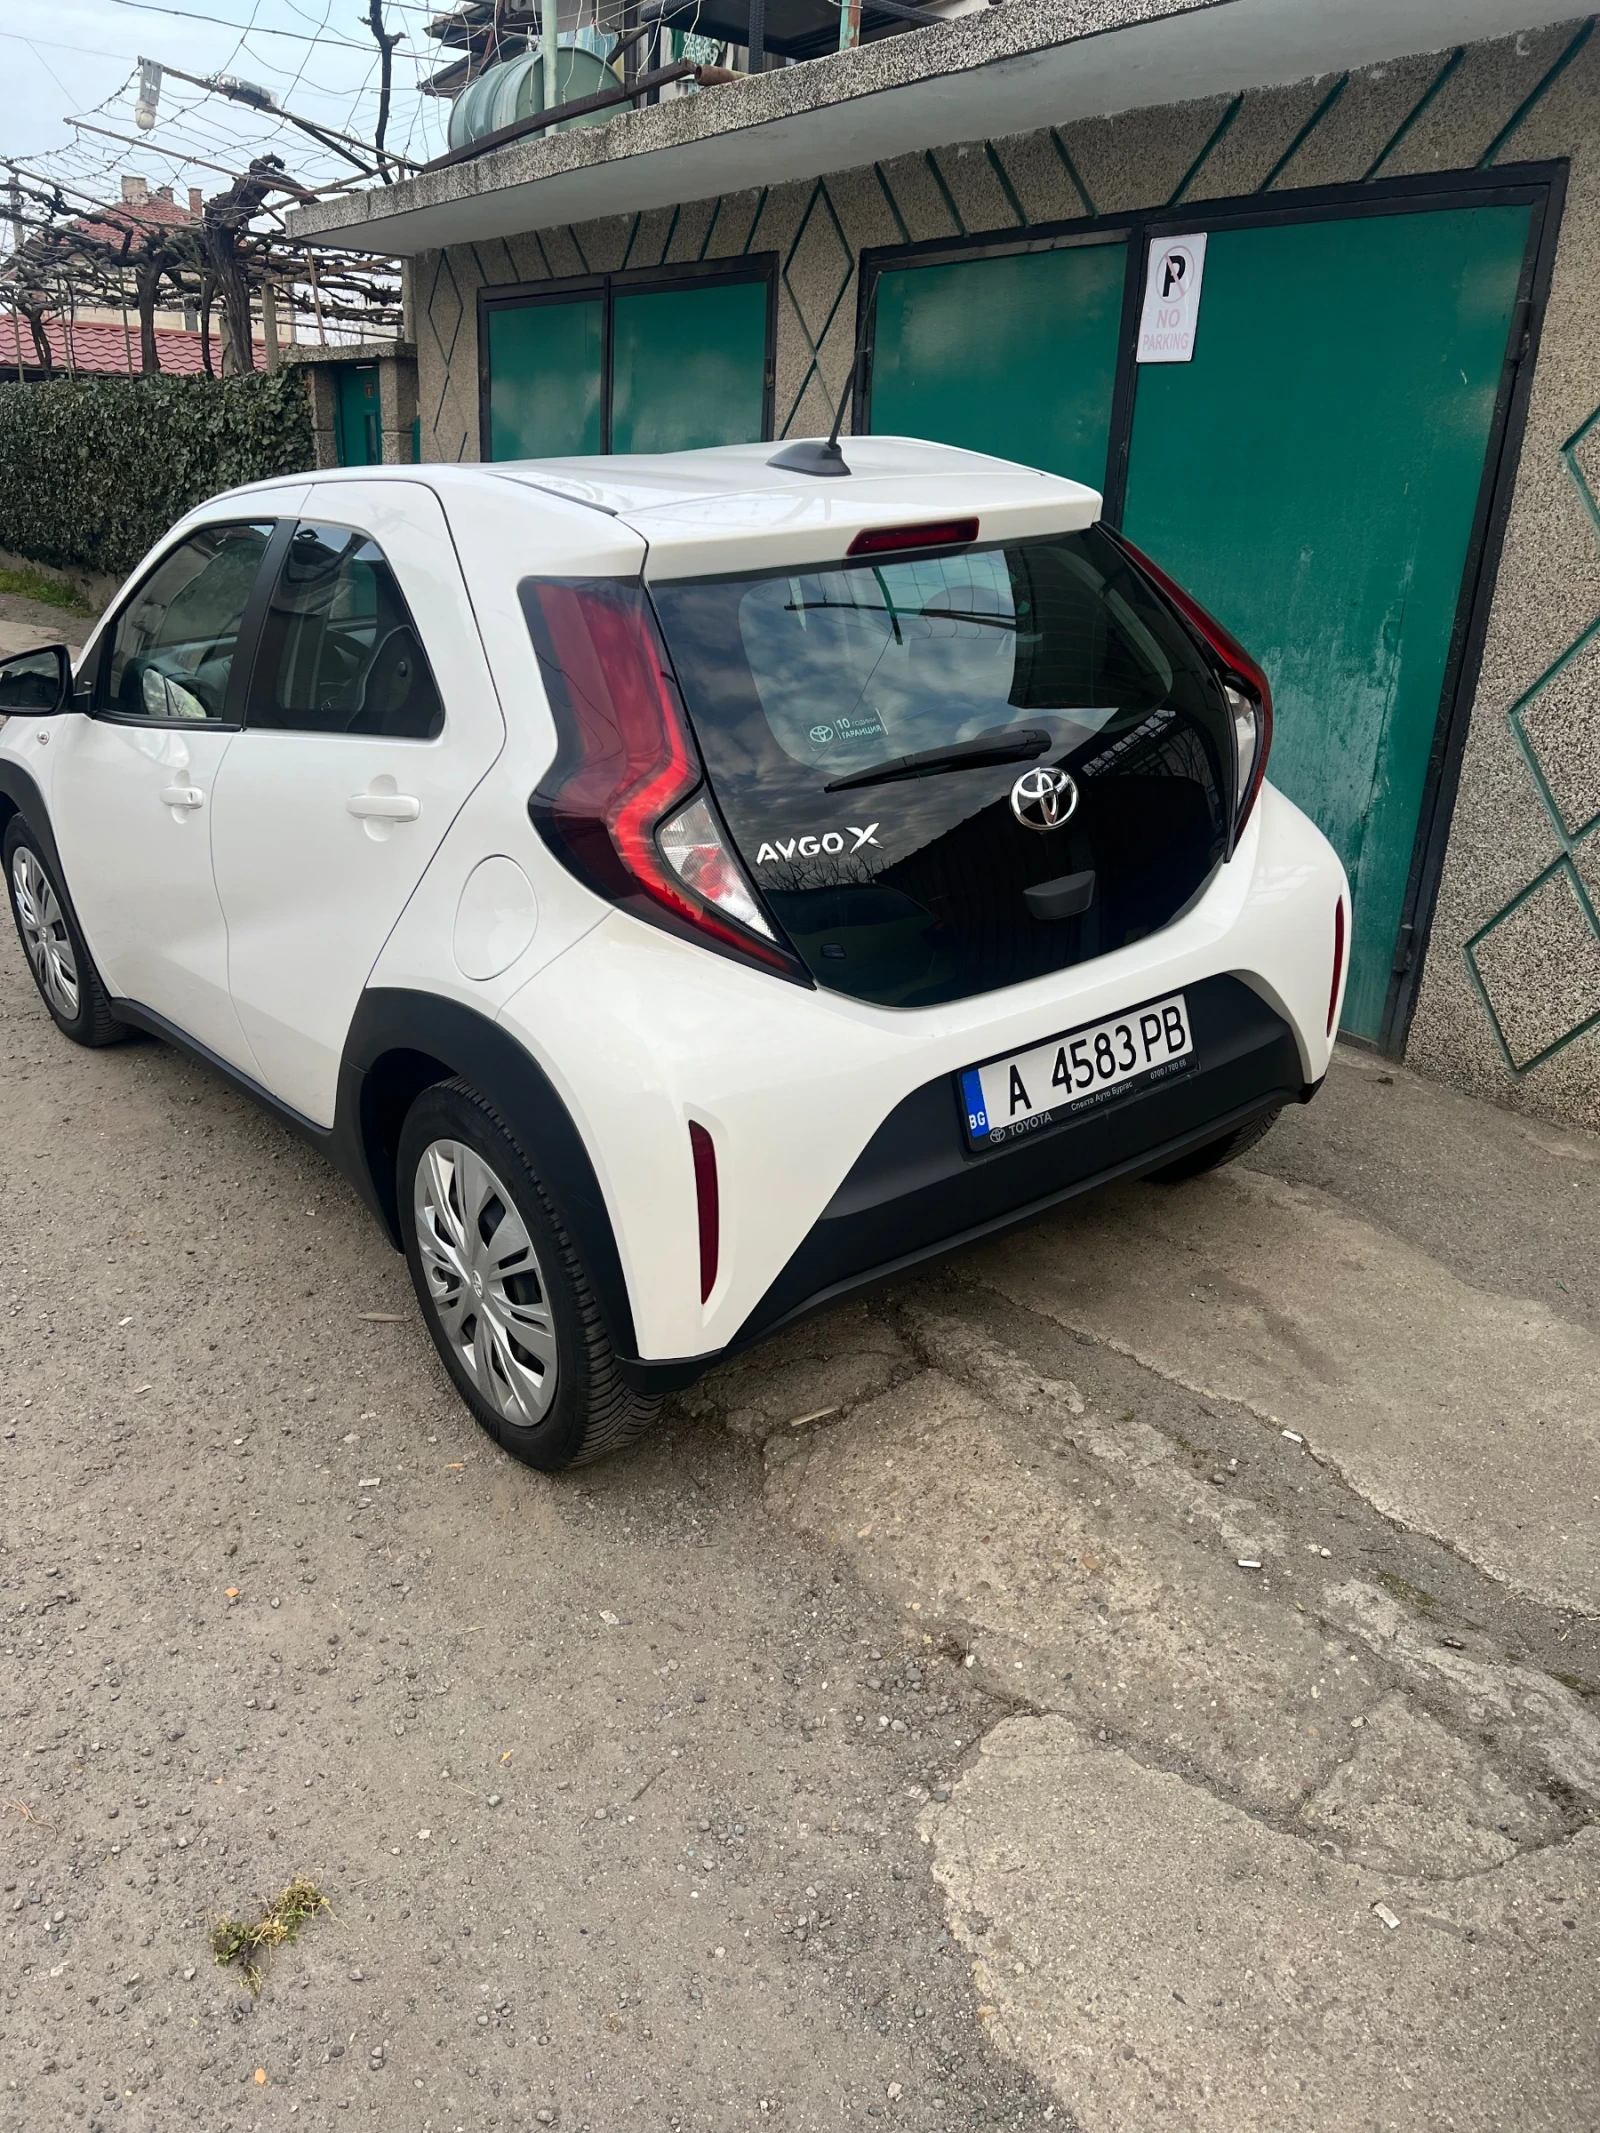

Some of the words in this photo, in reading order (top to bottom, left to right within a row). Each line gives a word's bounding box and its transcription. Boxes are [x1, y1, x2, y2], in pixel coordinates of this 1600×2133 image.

[1157, 309, 1180, 328] NO
[1143, 332, 1189, 351] PARKING
[836, 718, 850, 729] 10
[841, 724, 882, 739] ГАРАНЦИЯ
[1009, 1064, 1032, 1116] A
[1112, 1081, 1134, 1095] Бургас
[968, 1111, 986, 1130] BG
[1008, 1111, 1053, 1136] TOYOTA
